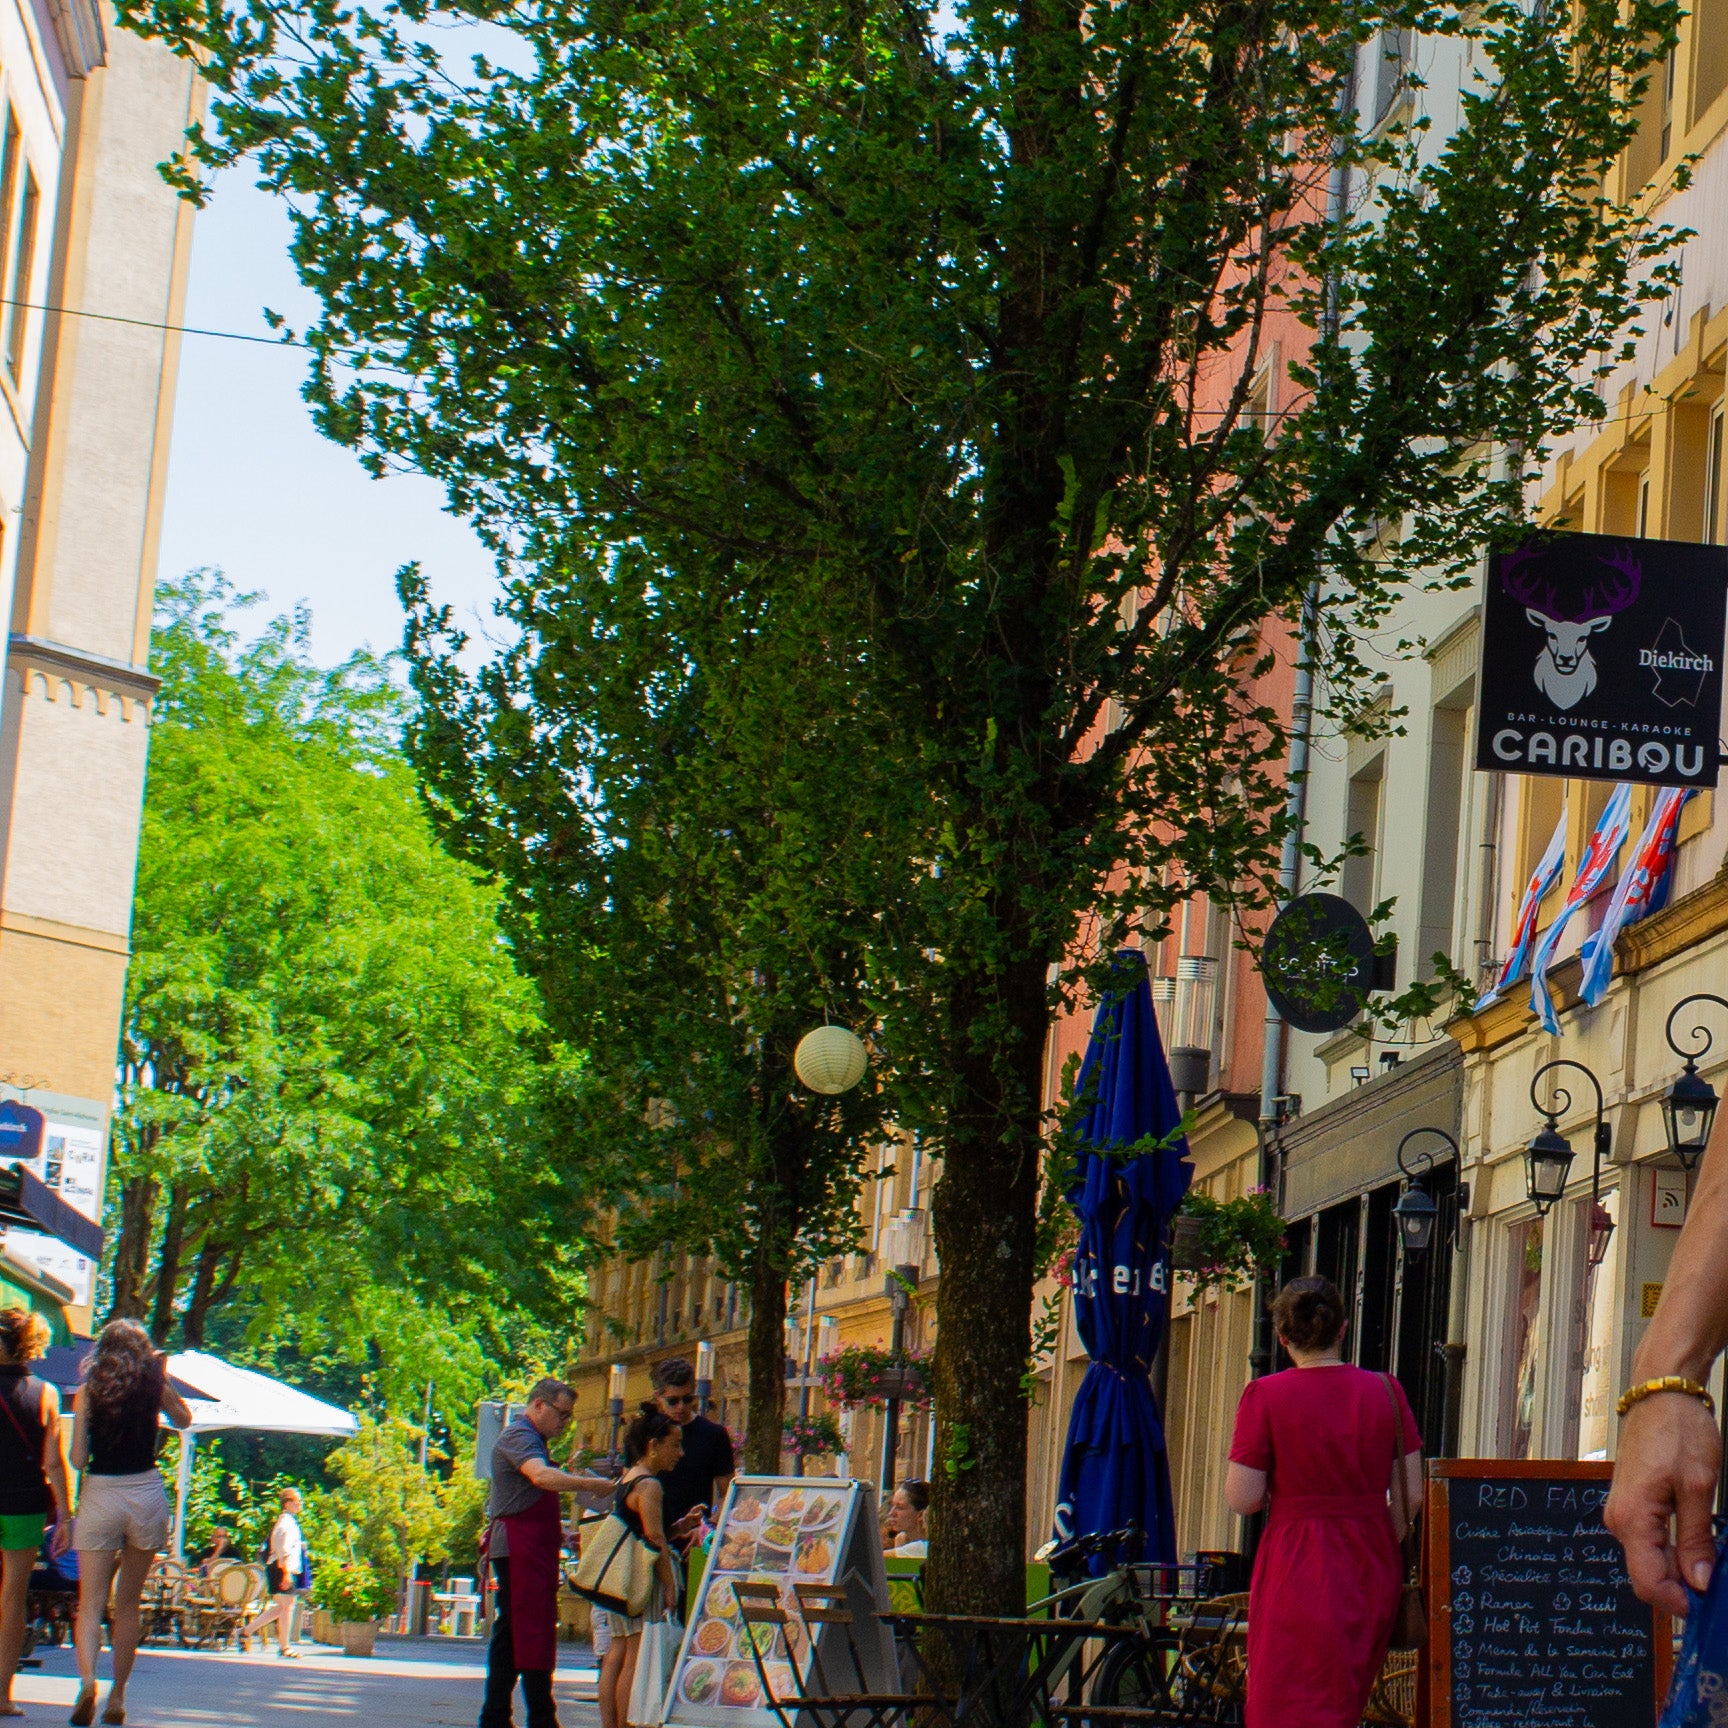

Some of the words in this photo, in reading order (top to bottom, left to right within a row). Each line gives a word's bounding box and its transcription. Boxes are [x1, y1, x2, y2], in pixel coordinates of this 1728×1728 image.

[1639, 649, 1714, 672] Diekirch
[1507, 712, 1536, 723] BAR
[1549, 715, 1609, 730] LOUNGE
[1621, 722, 1692, 737] KARAOKE
[1492, 728, 1704, 777] CARIBOU
[1478, 1483, 1528, 1511] RED
[1480, 1591, 1534, 1610] Ramen
